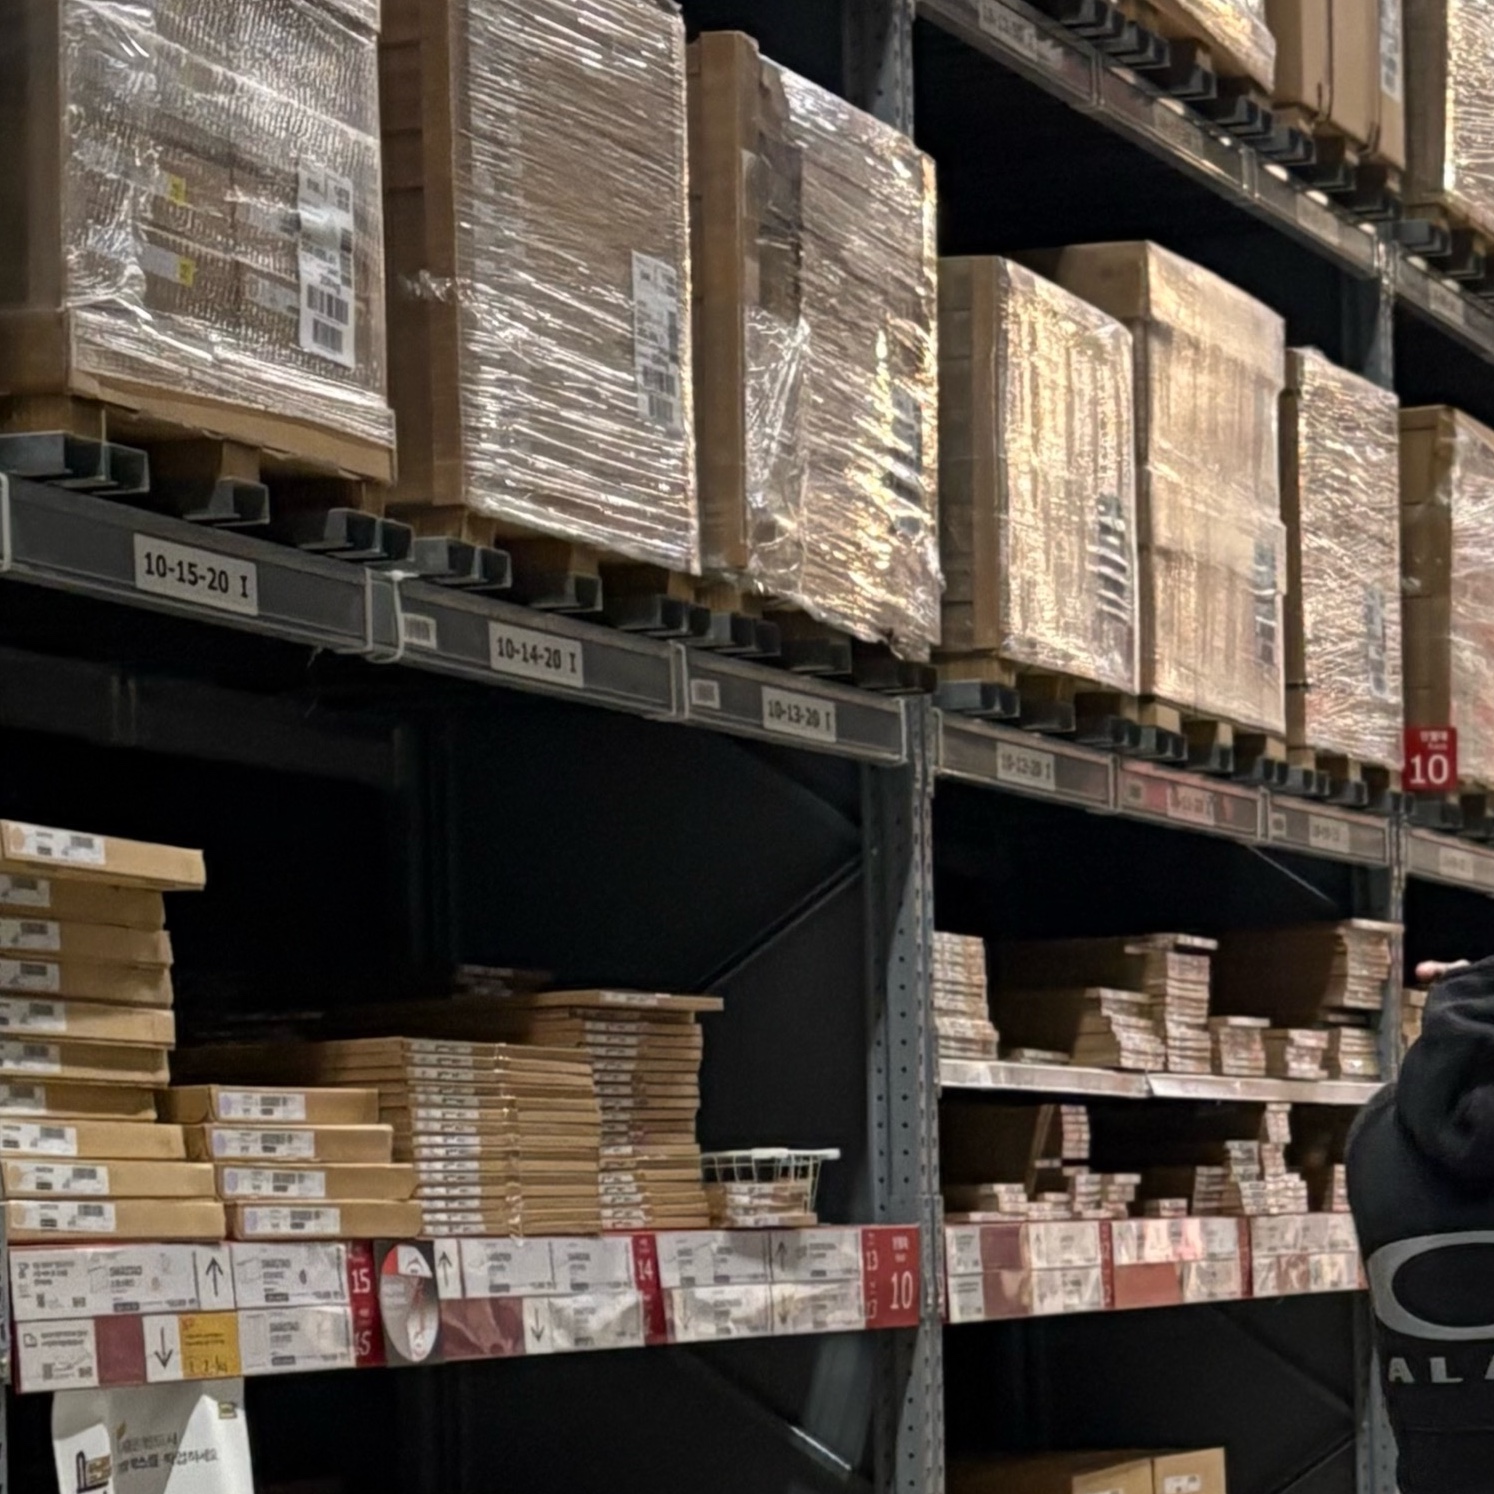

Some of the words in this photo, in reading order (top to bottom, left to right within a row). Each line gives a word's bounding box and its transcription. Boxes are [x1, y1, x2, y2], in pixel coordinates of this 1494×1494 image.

[145, 552, 229, 593] 10-15-20
[497, 637, 562, 670] 10-14-20
[1409, 753, 1449, 785] 10
[637, 1259, 653, 1280] 14
[865, 1248, 879, 1271] 13
[351, 1267, 371, 1293] 15
[889, 1270, 913, 1310] 10
